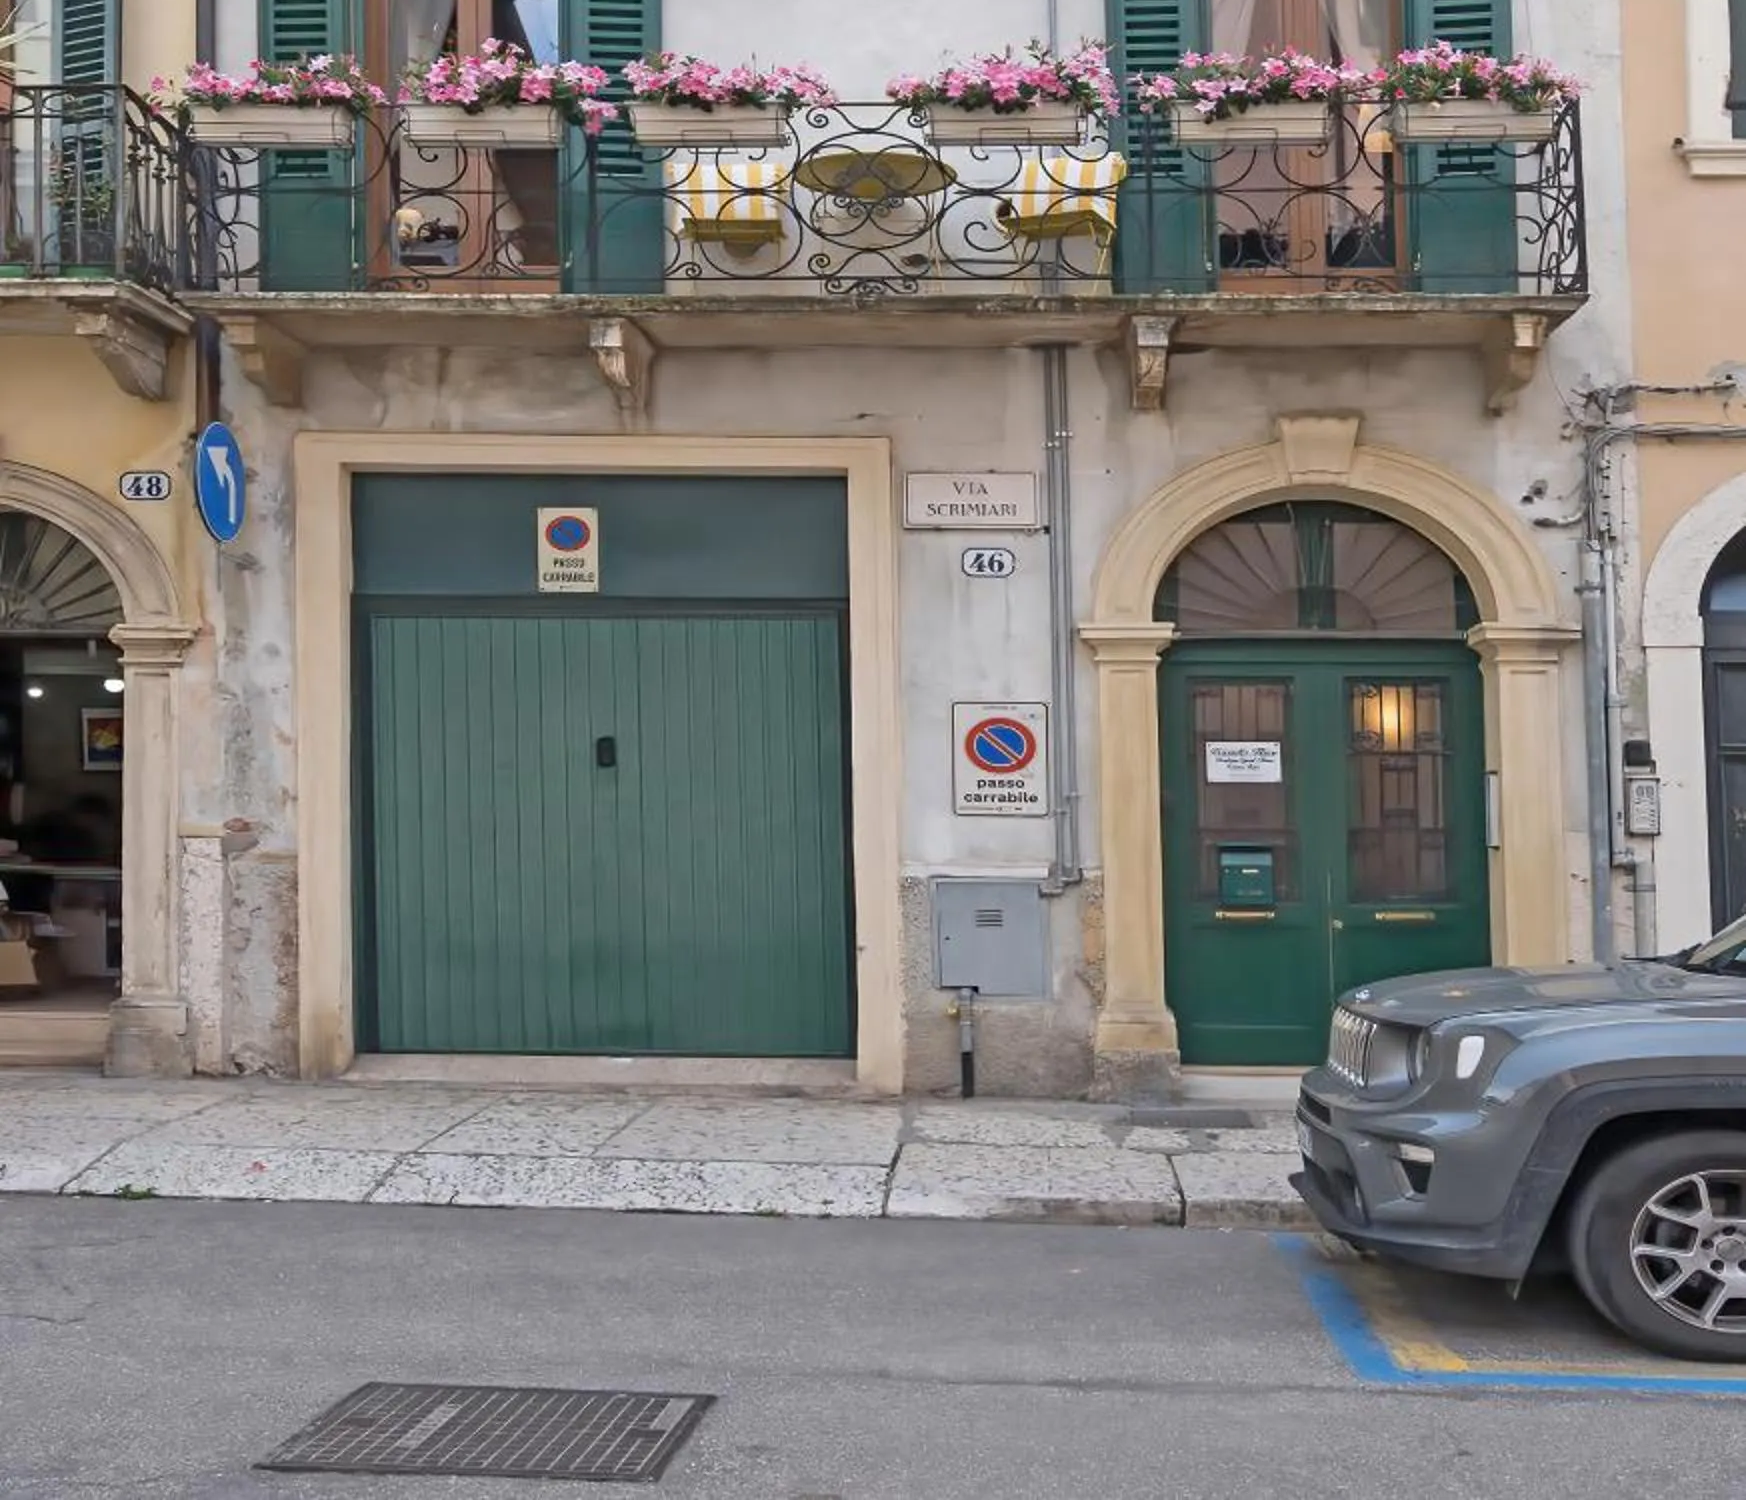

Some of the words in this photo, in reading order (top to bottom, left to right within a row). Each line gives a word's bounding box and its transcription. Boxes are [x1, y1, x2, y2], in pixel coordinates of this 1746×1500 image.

[127, 475, 162, 497] 48
[953, 481, 989, 495] VIA
[927, 503, 1018, 517] SCRIMIARI
[553, 558, 585, 568] PASSO
[969, 553, 1005, 573] 46
[977, 780, 1025, 789] passo
[963, 792, 1039, 803] carrabile
